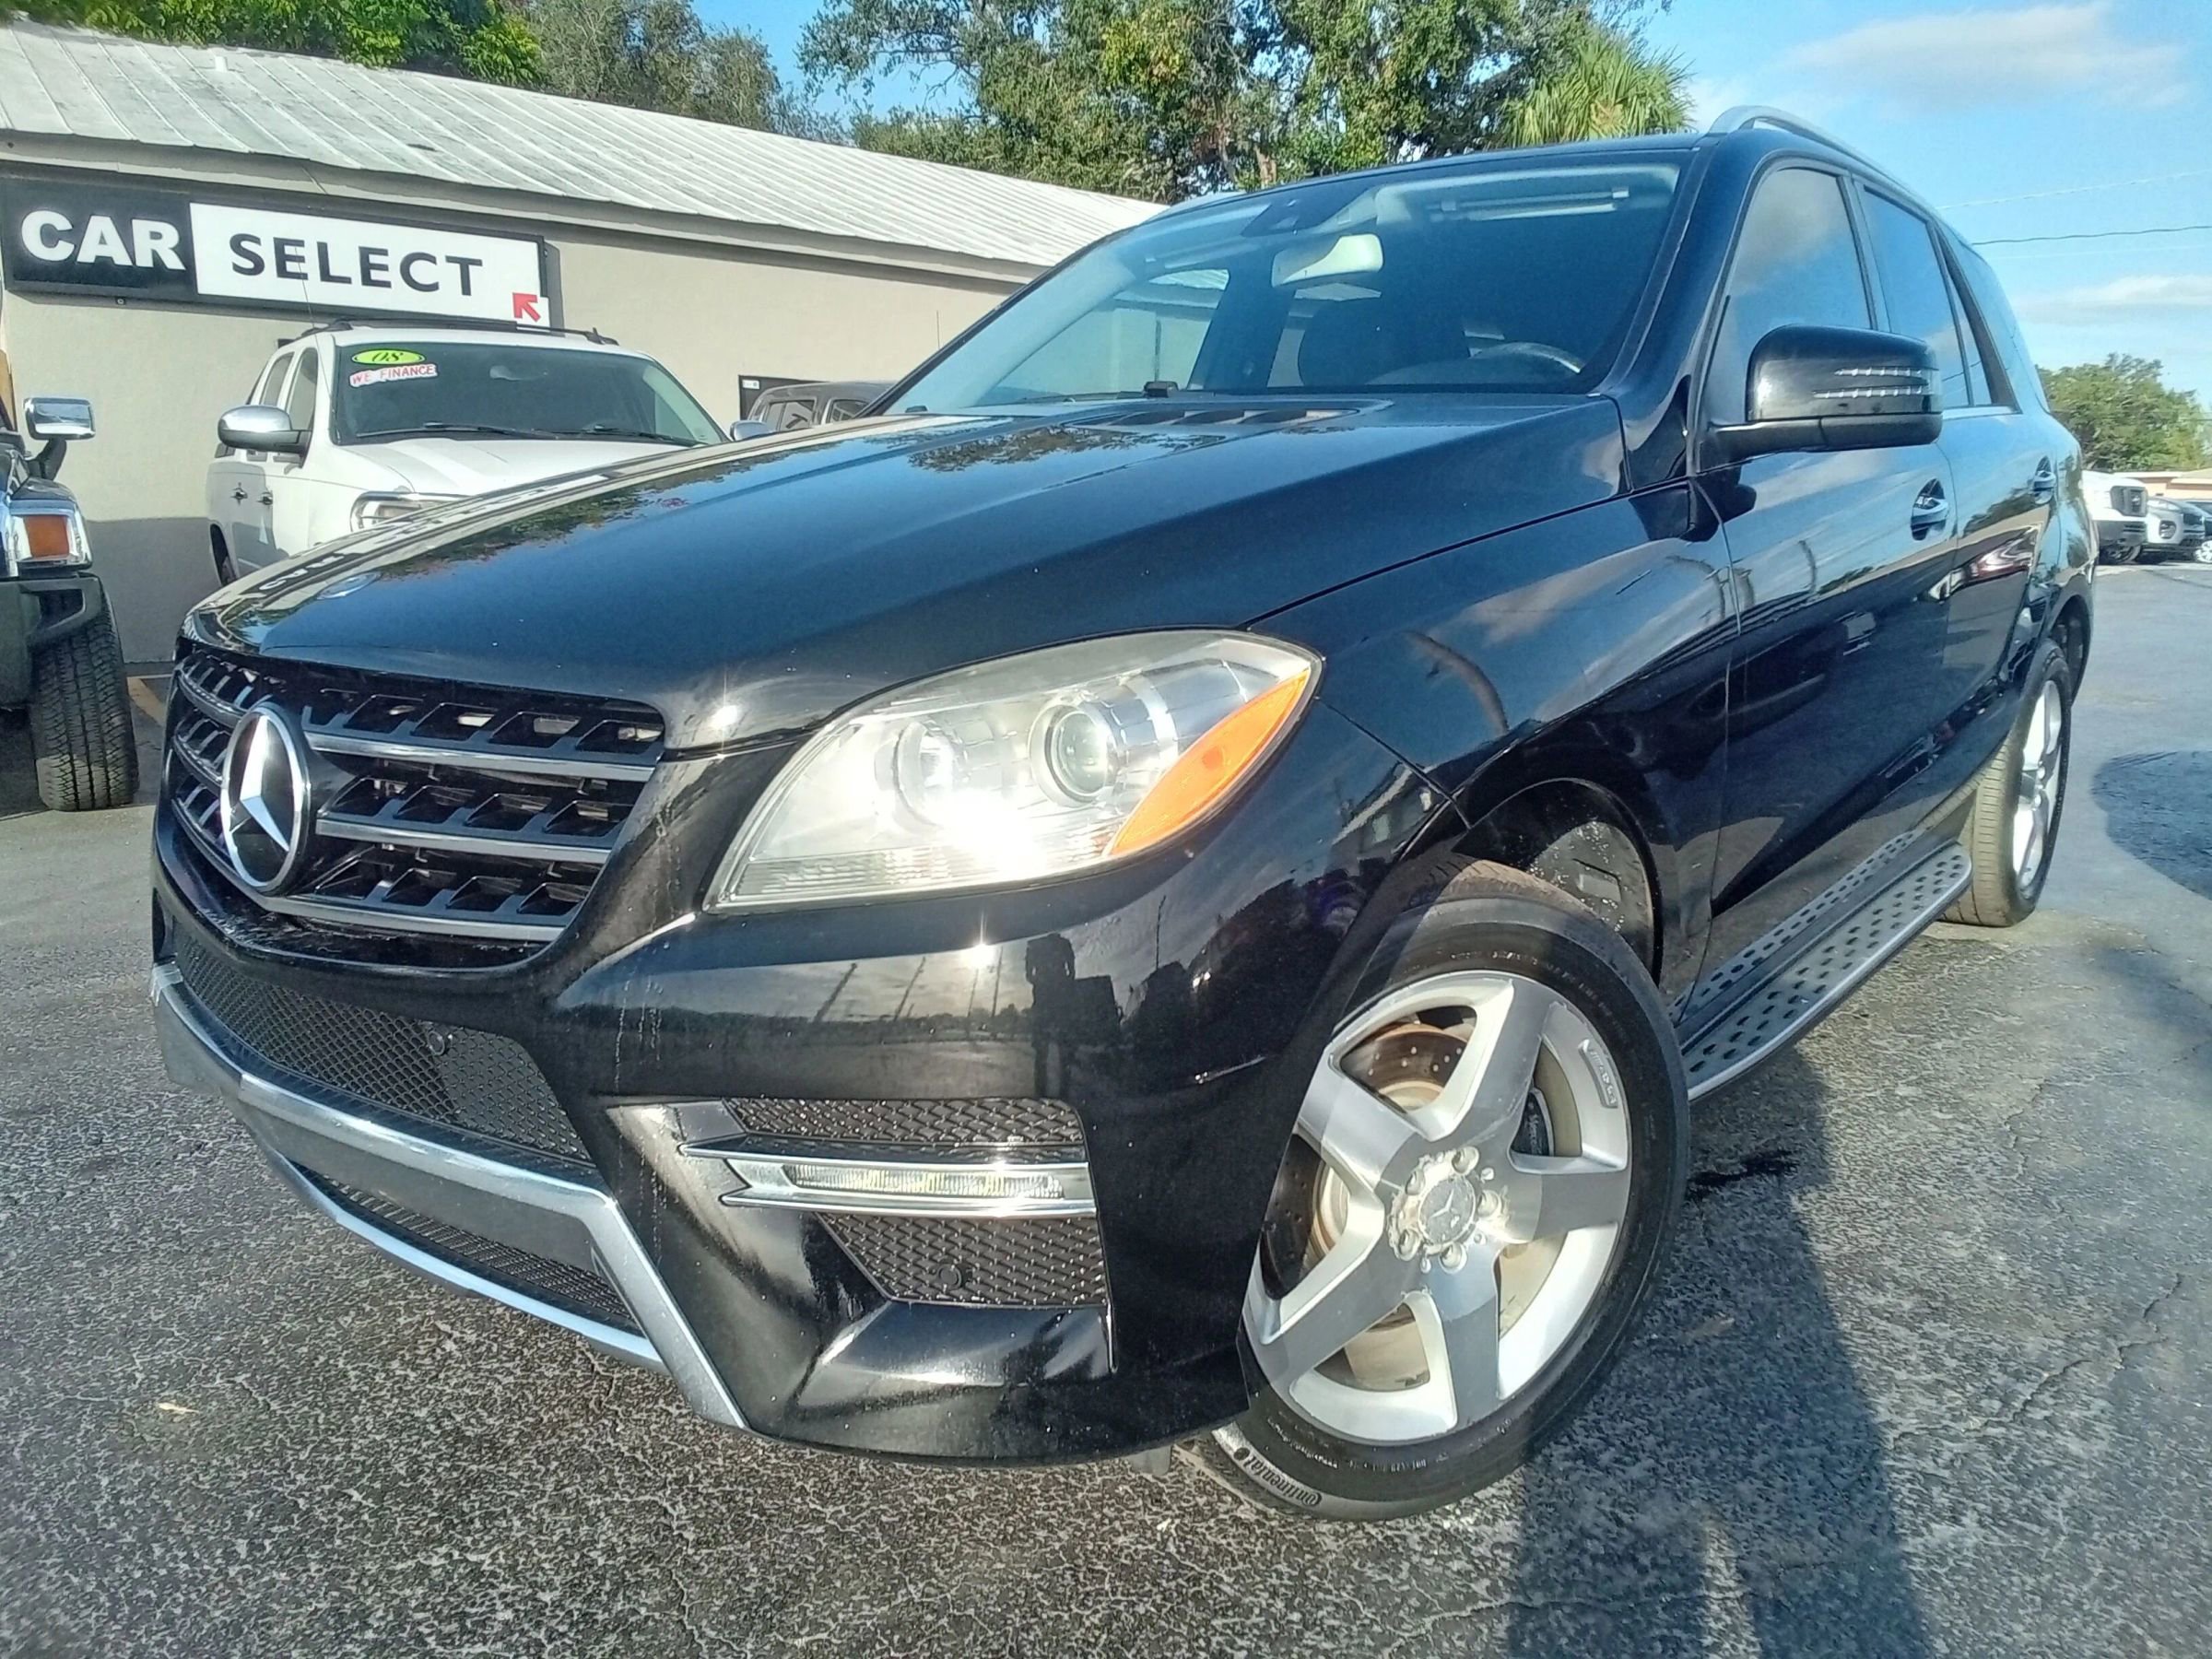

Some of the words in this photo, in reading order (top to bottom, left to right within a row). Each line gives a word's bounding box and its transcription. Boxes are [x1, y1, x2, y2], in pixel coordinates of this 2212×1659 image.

[21, 210, 186, 271] CAR
[229, 233, 483, 297] SELECT
[352, 372, 373, 385] WE
[380, 364, 435, 380] FINANCE
